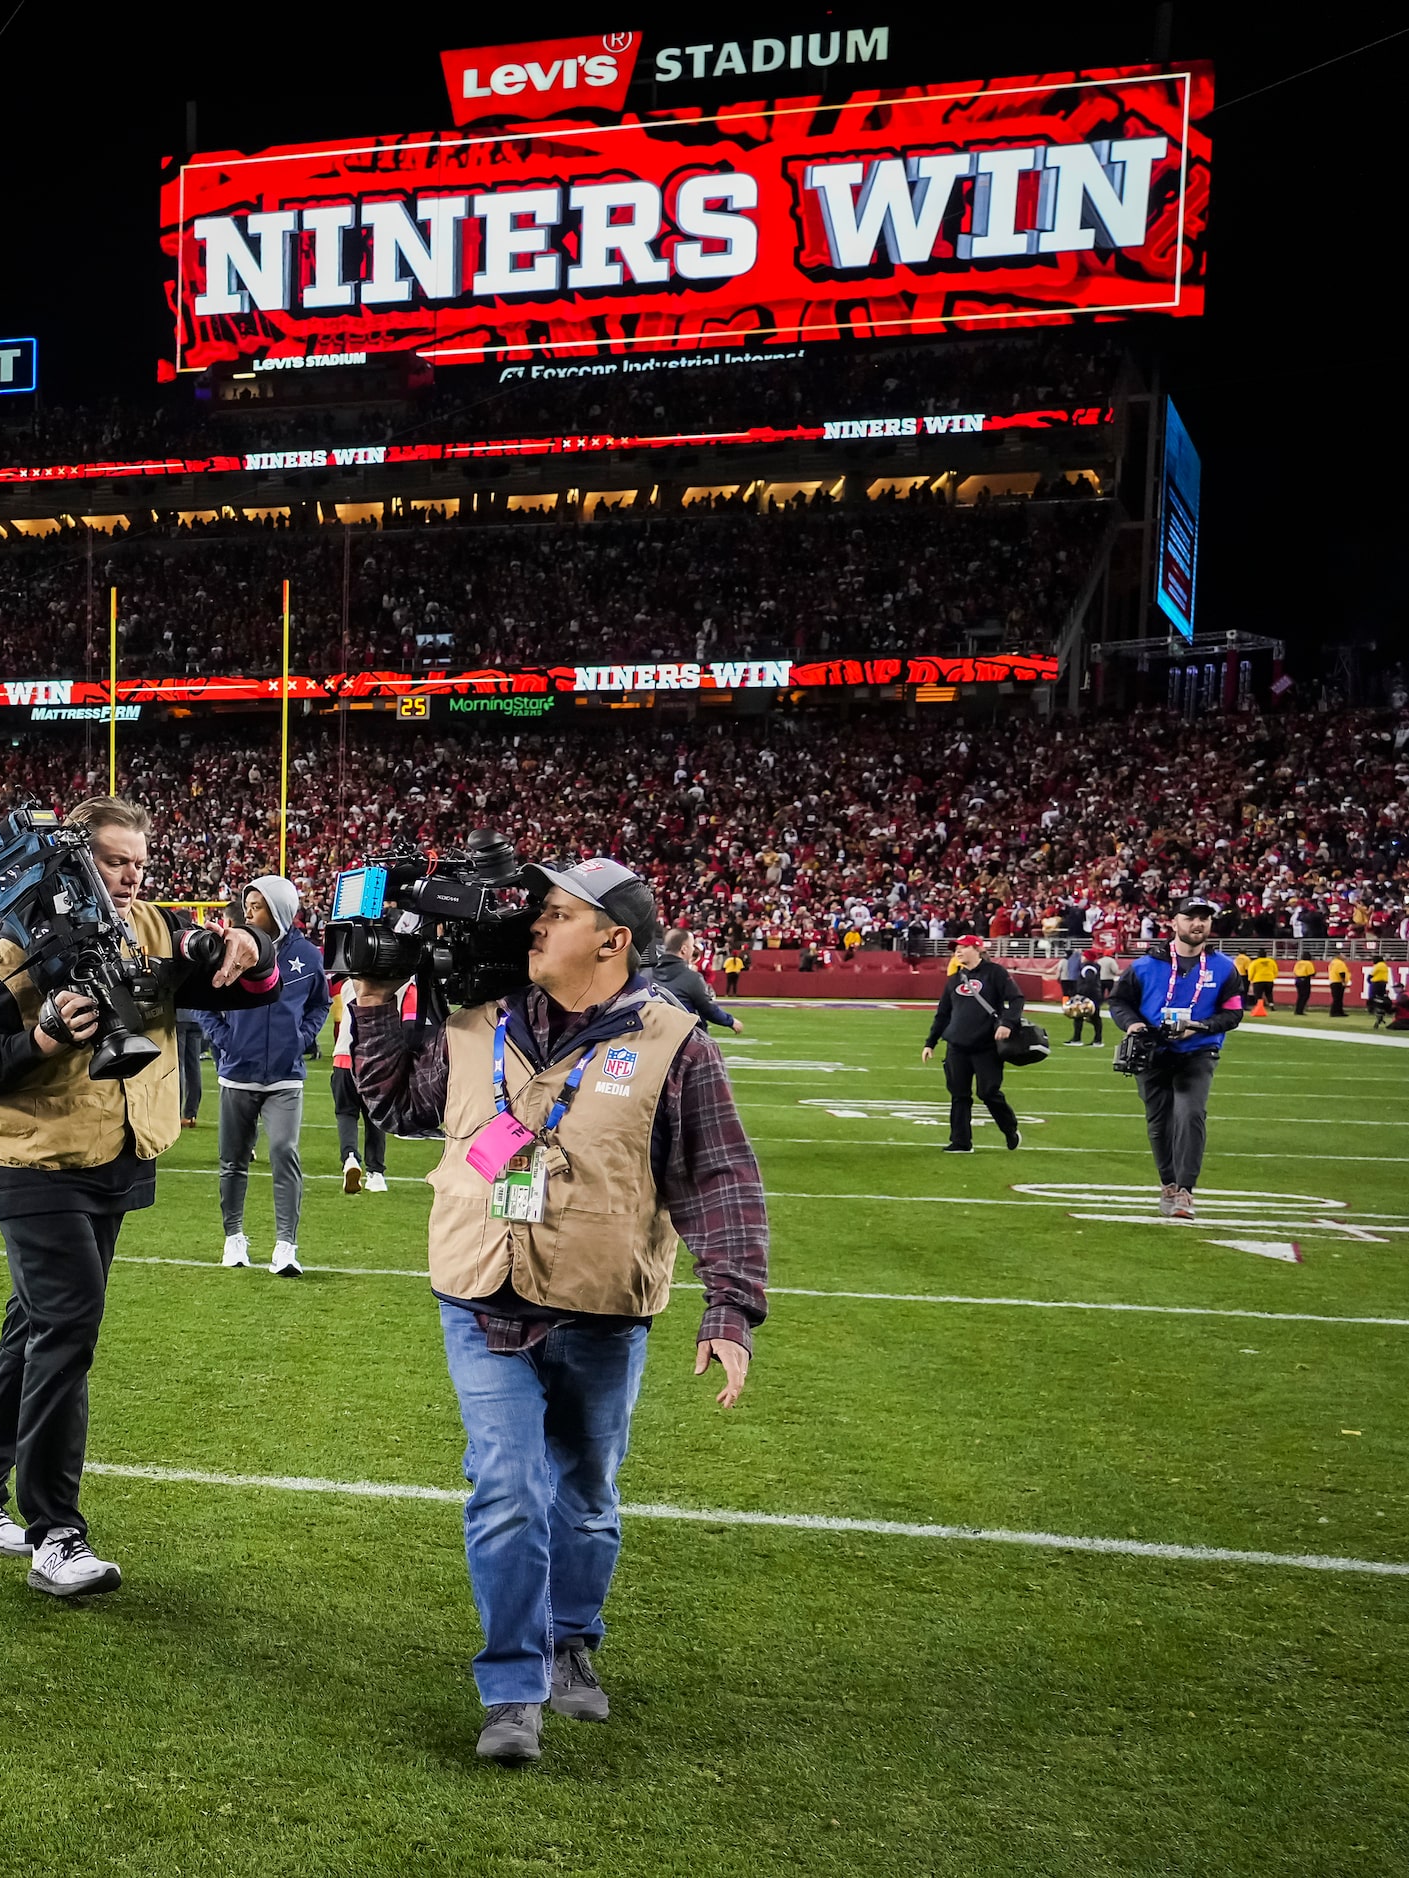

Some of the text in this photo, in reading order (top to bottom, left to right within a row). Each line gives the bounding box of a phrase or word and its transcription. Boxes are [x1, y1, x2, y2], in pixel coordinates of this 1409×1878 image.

[655, 26, 889, 82] STADIUM
[194, 136, 1168, 317] NINERS WIN
[305, 352, 367, 368] STADIUM
[823, 414, 985, 439] NINERS WIN
[245, 447, 387, 470] NINERS WIN
[573, 661, 792, 691] NINERS WIN
[4, 680, 74, 705] WIN
[401, 698, 425, 716] 25
[450, 696, 546, 715] MorningStar
[607, 1059, 630, 1076] NFL
[595, 1082, 630, 1097] MEDIA
